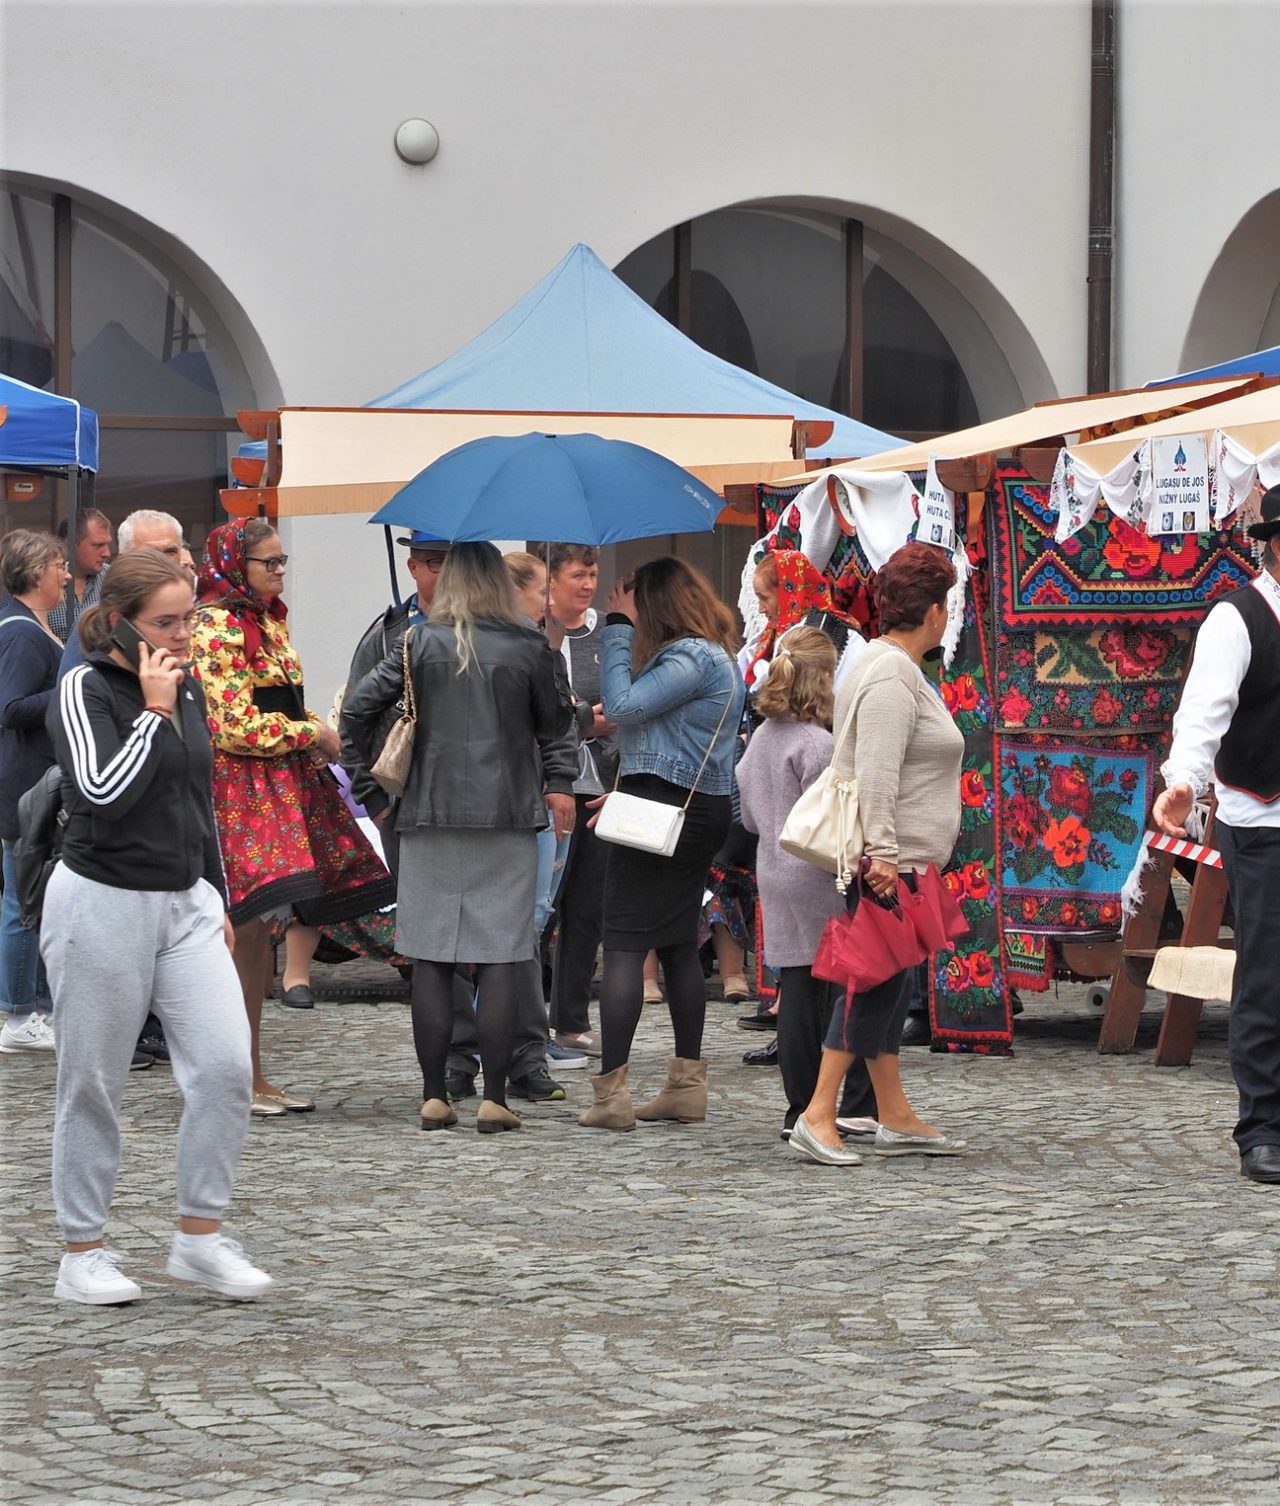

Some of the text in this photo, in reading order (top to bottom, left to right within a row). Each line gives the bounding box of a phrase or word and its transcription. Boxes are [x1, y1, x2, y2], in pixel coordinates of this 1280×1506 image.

[1182, 477, 1191, 488] DE
[1191, 476, 1205, 487] JOS
[928, 490, 945, 504] HUTA
[926, 505, 943, 518] HUTA
